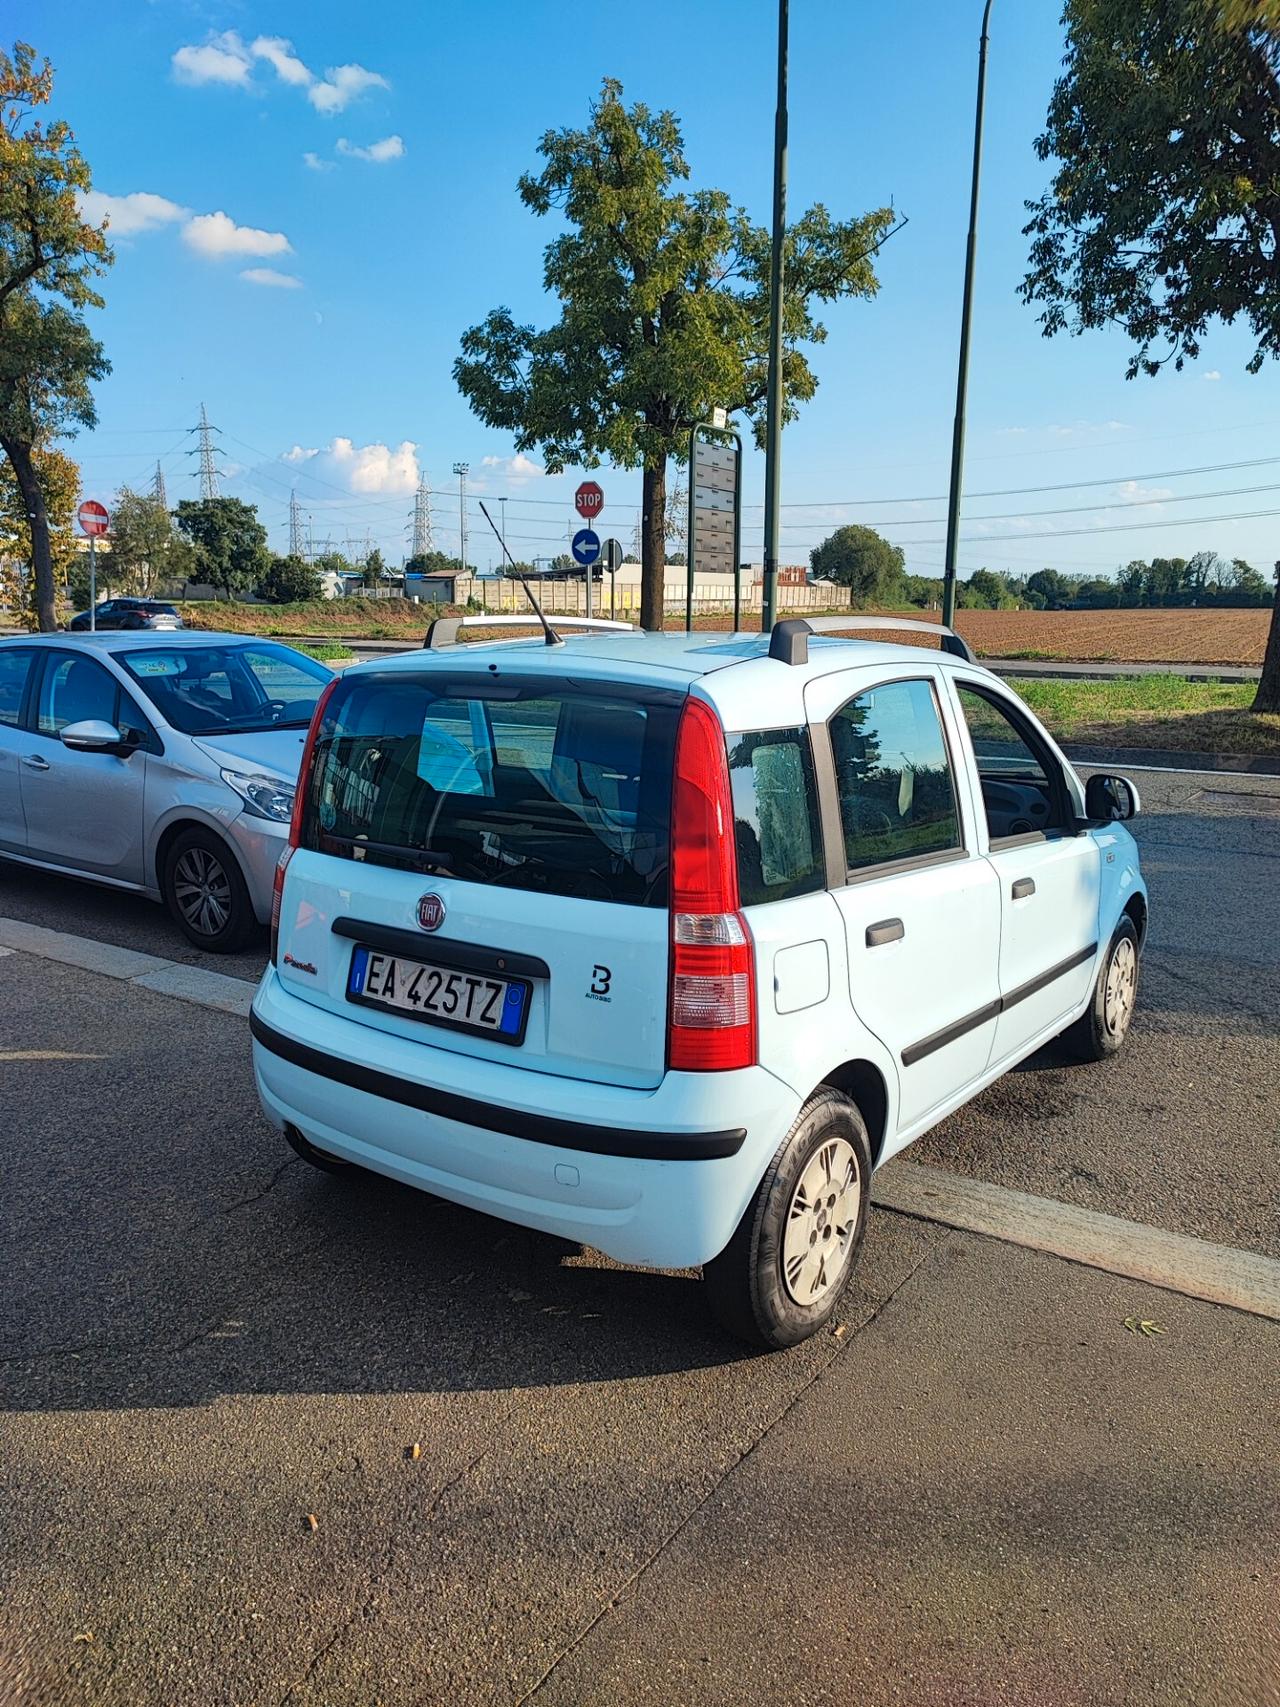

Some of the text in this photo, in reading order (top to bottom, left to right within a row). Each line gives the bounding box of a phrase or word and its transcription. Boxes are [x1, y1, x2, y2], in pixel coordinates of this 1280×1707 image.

[577, 494, 601, 507] STOP
[421, 903, 438, 921] FIAT
[366, 955, 501, 1024] EA 425TZ
